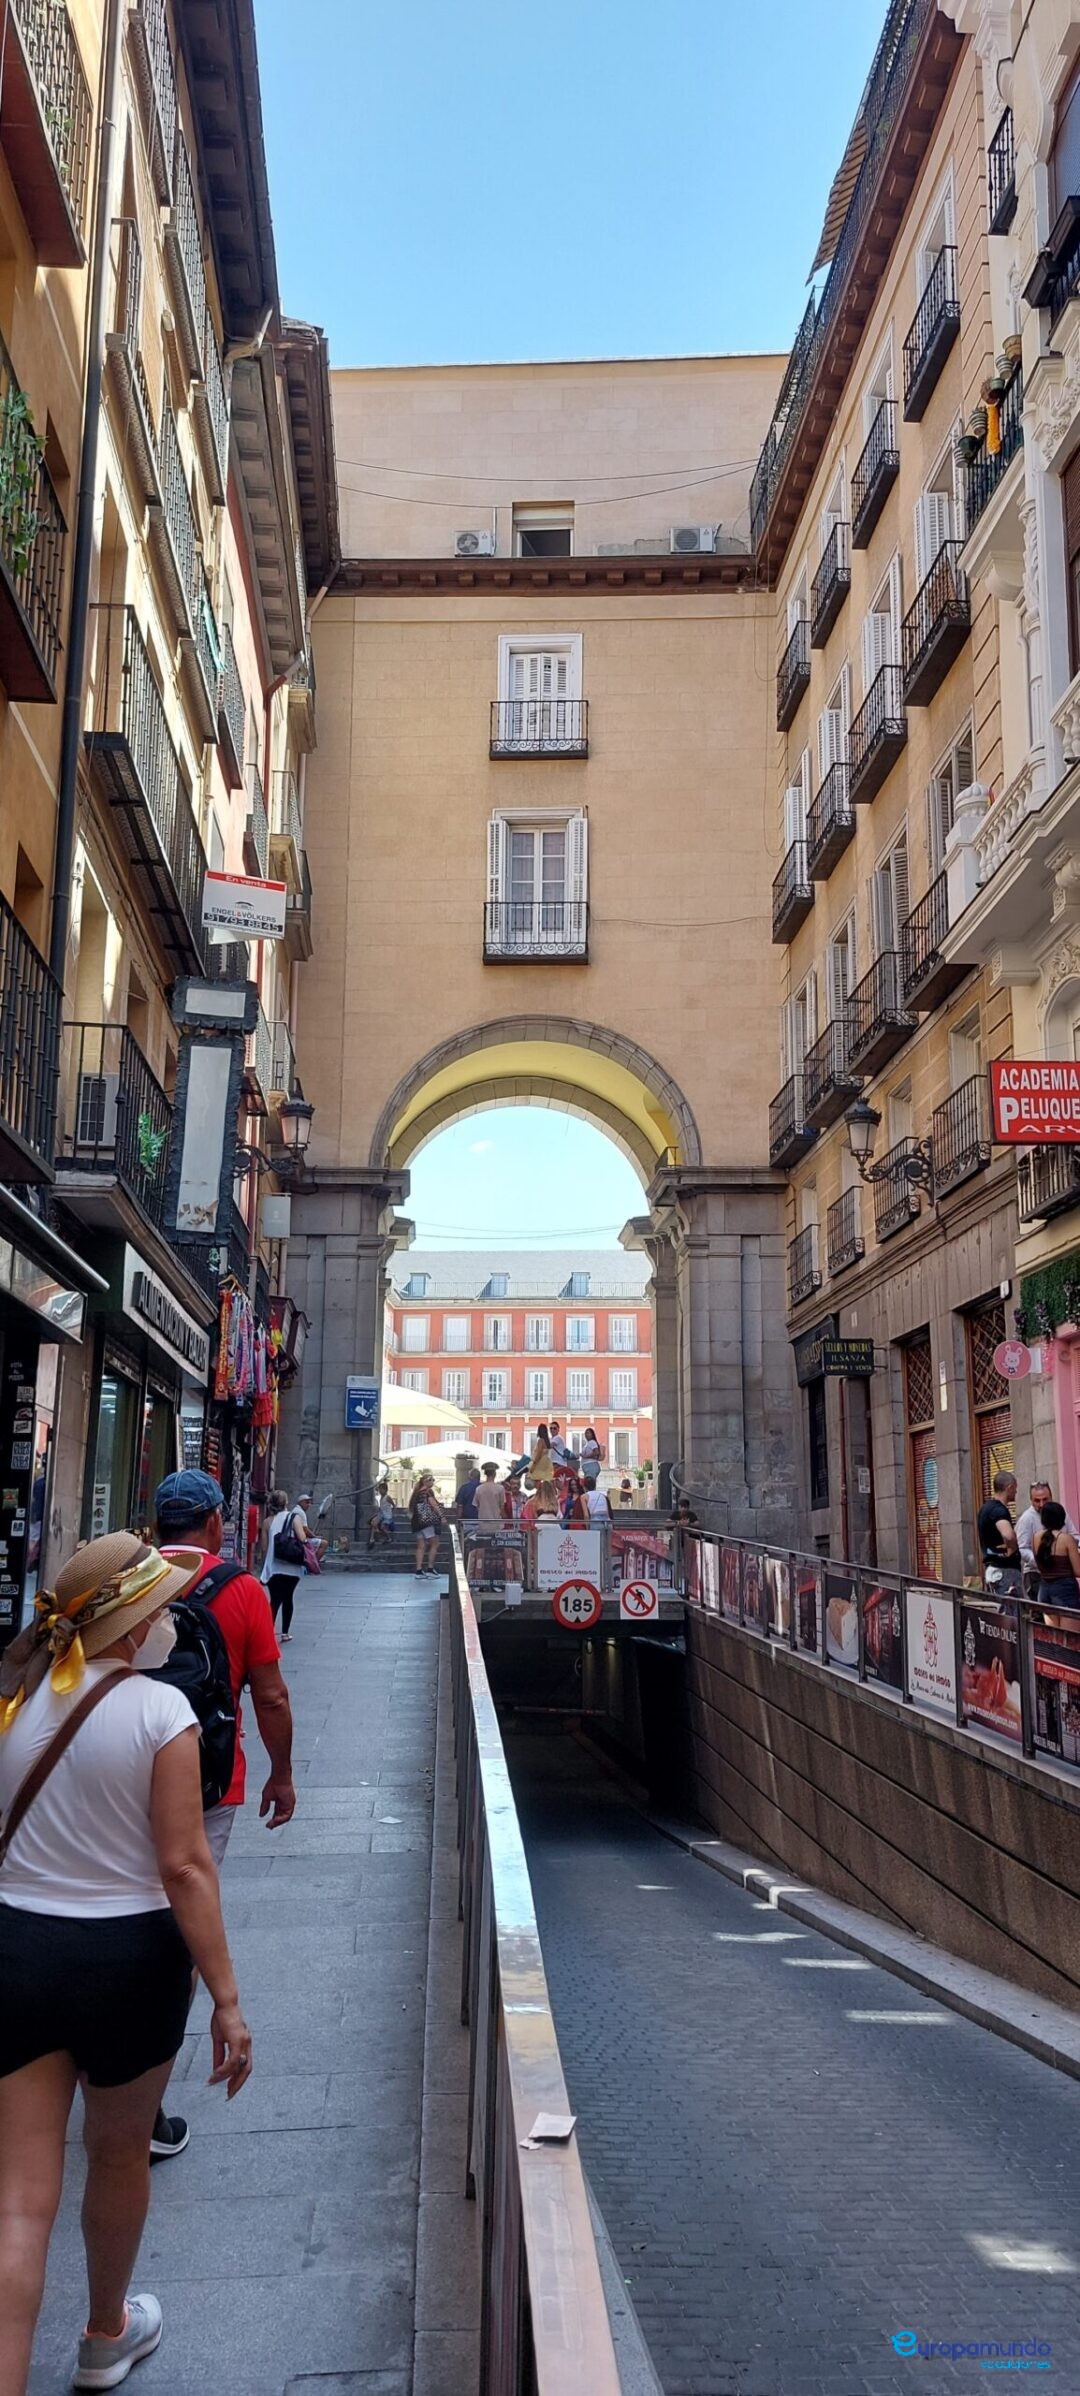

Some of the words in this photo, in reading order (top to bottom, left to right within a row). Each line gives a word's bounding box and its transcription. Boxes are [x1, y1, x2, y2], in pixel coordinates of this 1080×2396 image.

[240, 879, 267, 888] venta
[999, 1068, 1080, 1091] ACADEMIA
[562, 1596, 593, 1613] 1.85
[986, 1624, 1000, 1639] TIENDA
[1001, 1627, 1018, 1644] ONLINE
